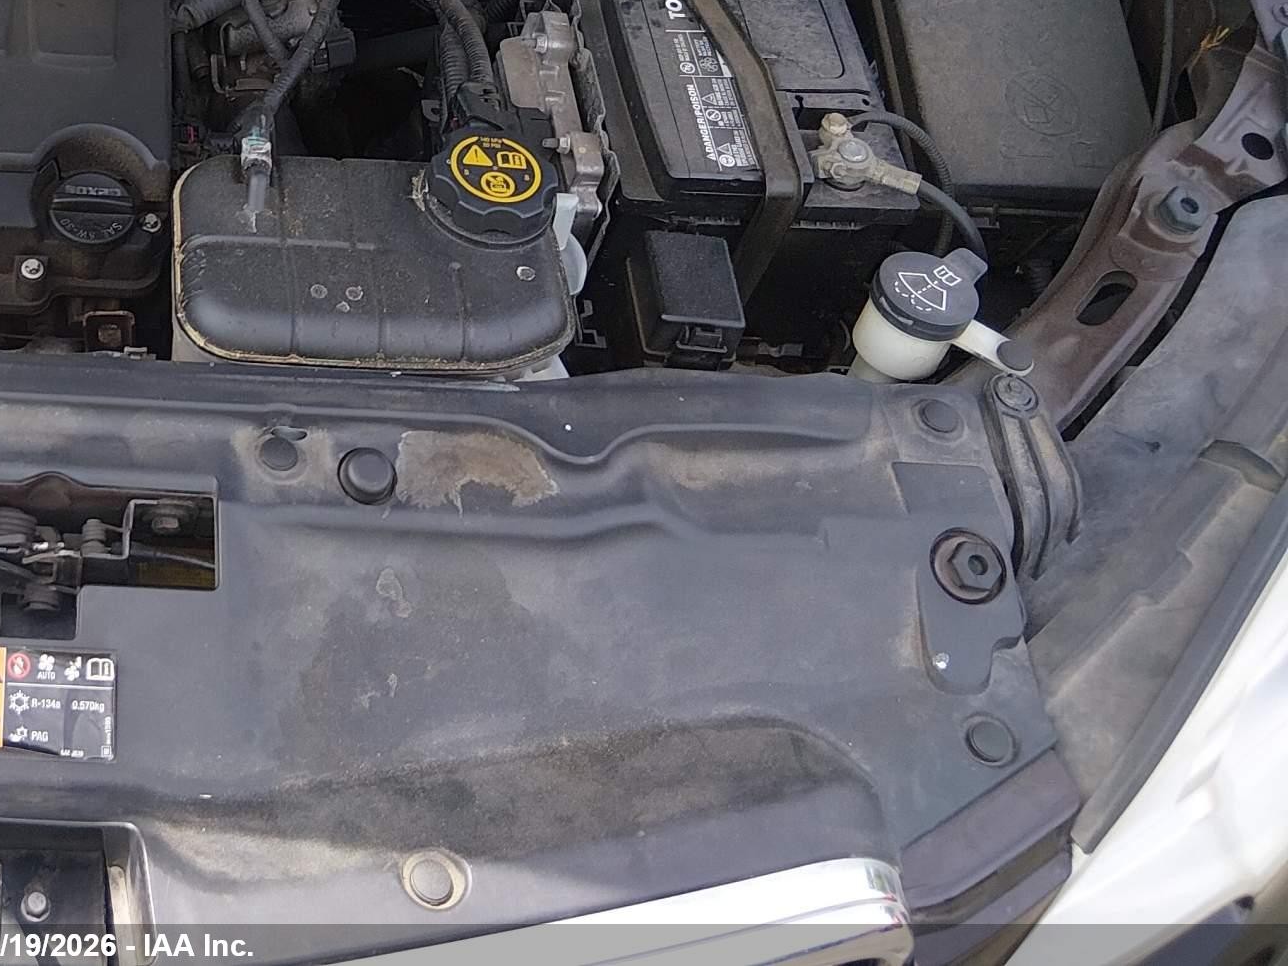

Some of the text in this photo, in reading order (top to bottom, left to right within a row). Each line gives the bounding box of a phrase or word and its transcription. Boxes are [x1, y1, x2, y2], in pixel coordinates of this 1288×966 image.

[685, 84, 716, 153] DANGER/POISON
[37, 671, 56, 680] AUTO
[31, 698, 105, 713] R-134a 0.570kg
[31, 730, 49, 743] PAG
